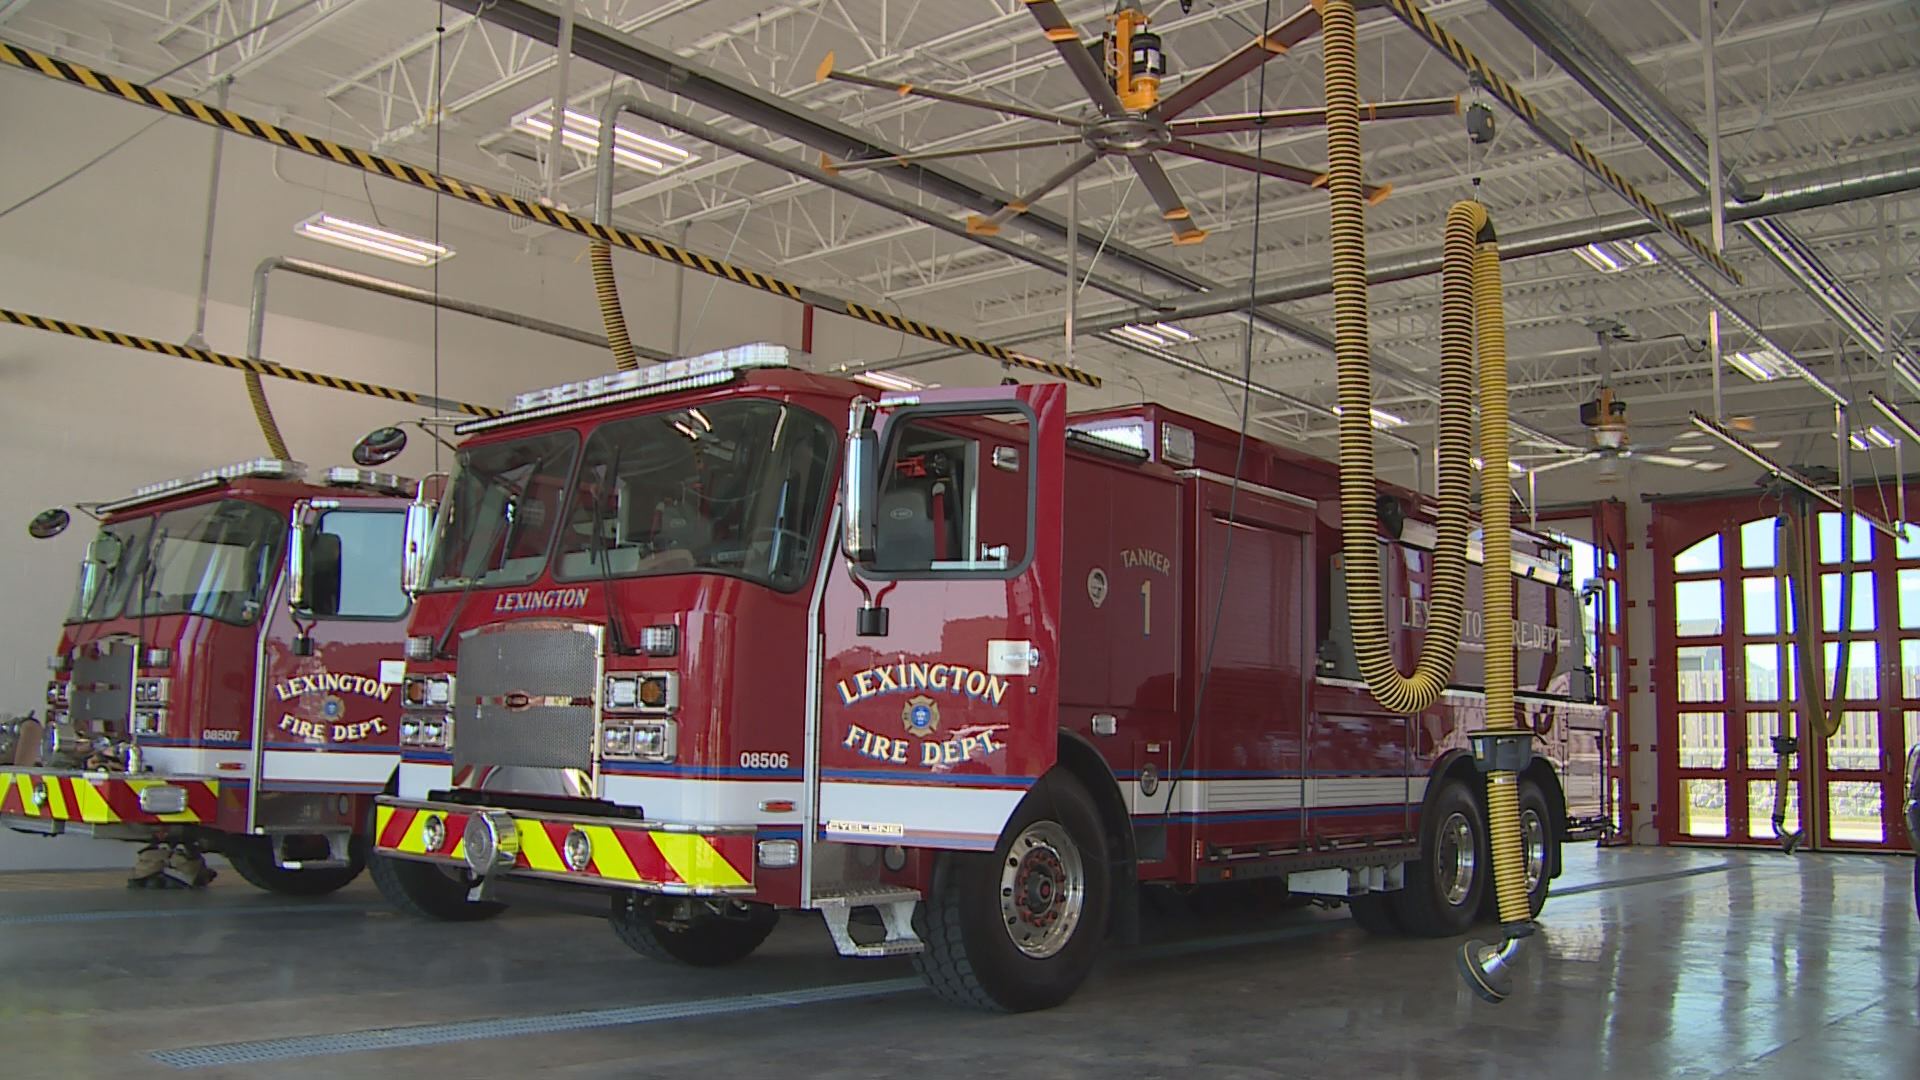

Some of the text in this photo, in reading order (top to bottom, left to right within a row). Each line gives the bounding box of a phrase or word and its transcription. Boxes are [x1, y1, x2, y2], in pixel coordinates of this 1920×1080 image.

[1120, 548, 1171, 577] TANKER
[493, 587, 589, 613] LEXINGTON
[1140, 579, 1151, 640] 1
[276, 673, 393, 702] LEXINGTON
[837, 662, 1010, 706] LEXINGTON
[203, 729, 241, 742] 08507
[279, 712, 388, 742] FIRE DEPT.
[843, 723, 1002, 768] FIRE DEPT.
[740, 752, 790, 769] 08506
